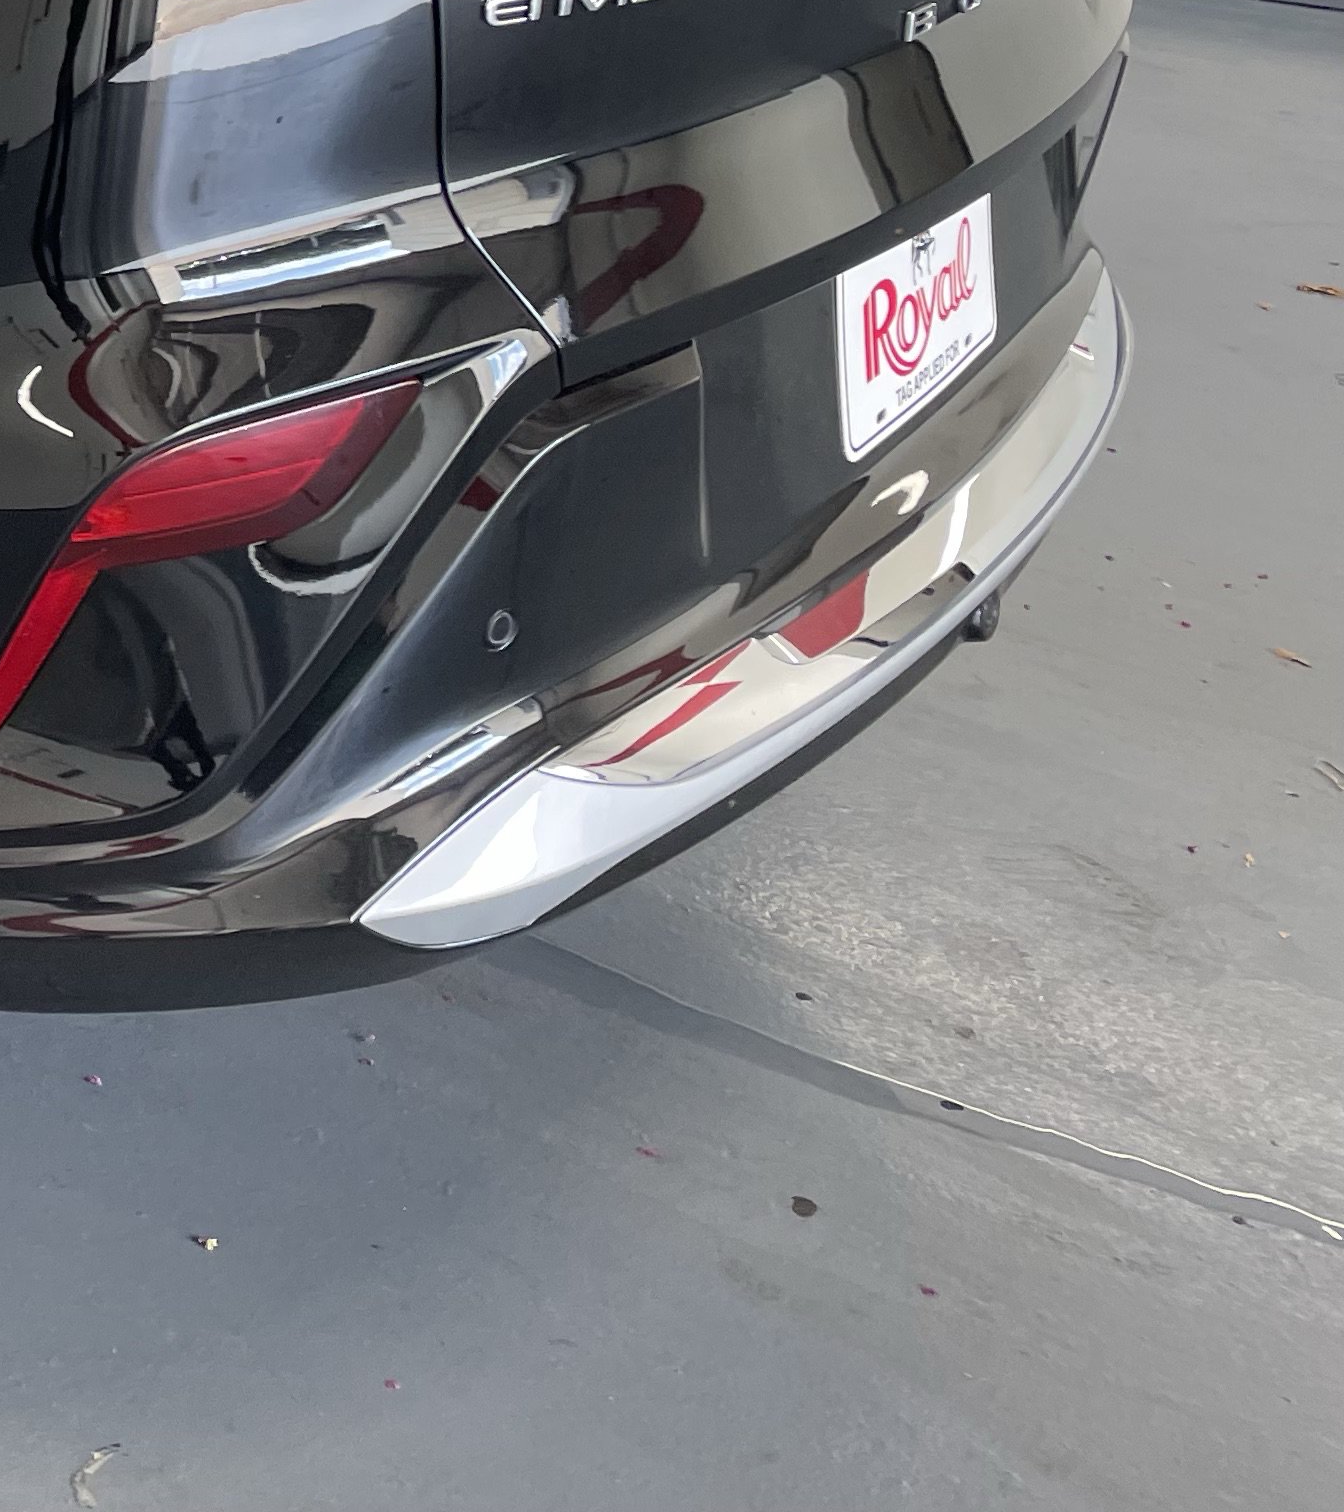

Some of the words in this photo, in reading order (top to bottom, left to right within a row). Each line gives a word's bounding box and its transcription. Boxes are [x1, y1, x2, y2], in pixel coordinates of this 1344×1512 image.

[863, 217, 977, 384] Royal
[895, 380, 913, 407] TAG
[912, 352, 945, 395] APPLIED
[945, 339, 961, 368] FOR
